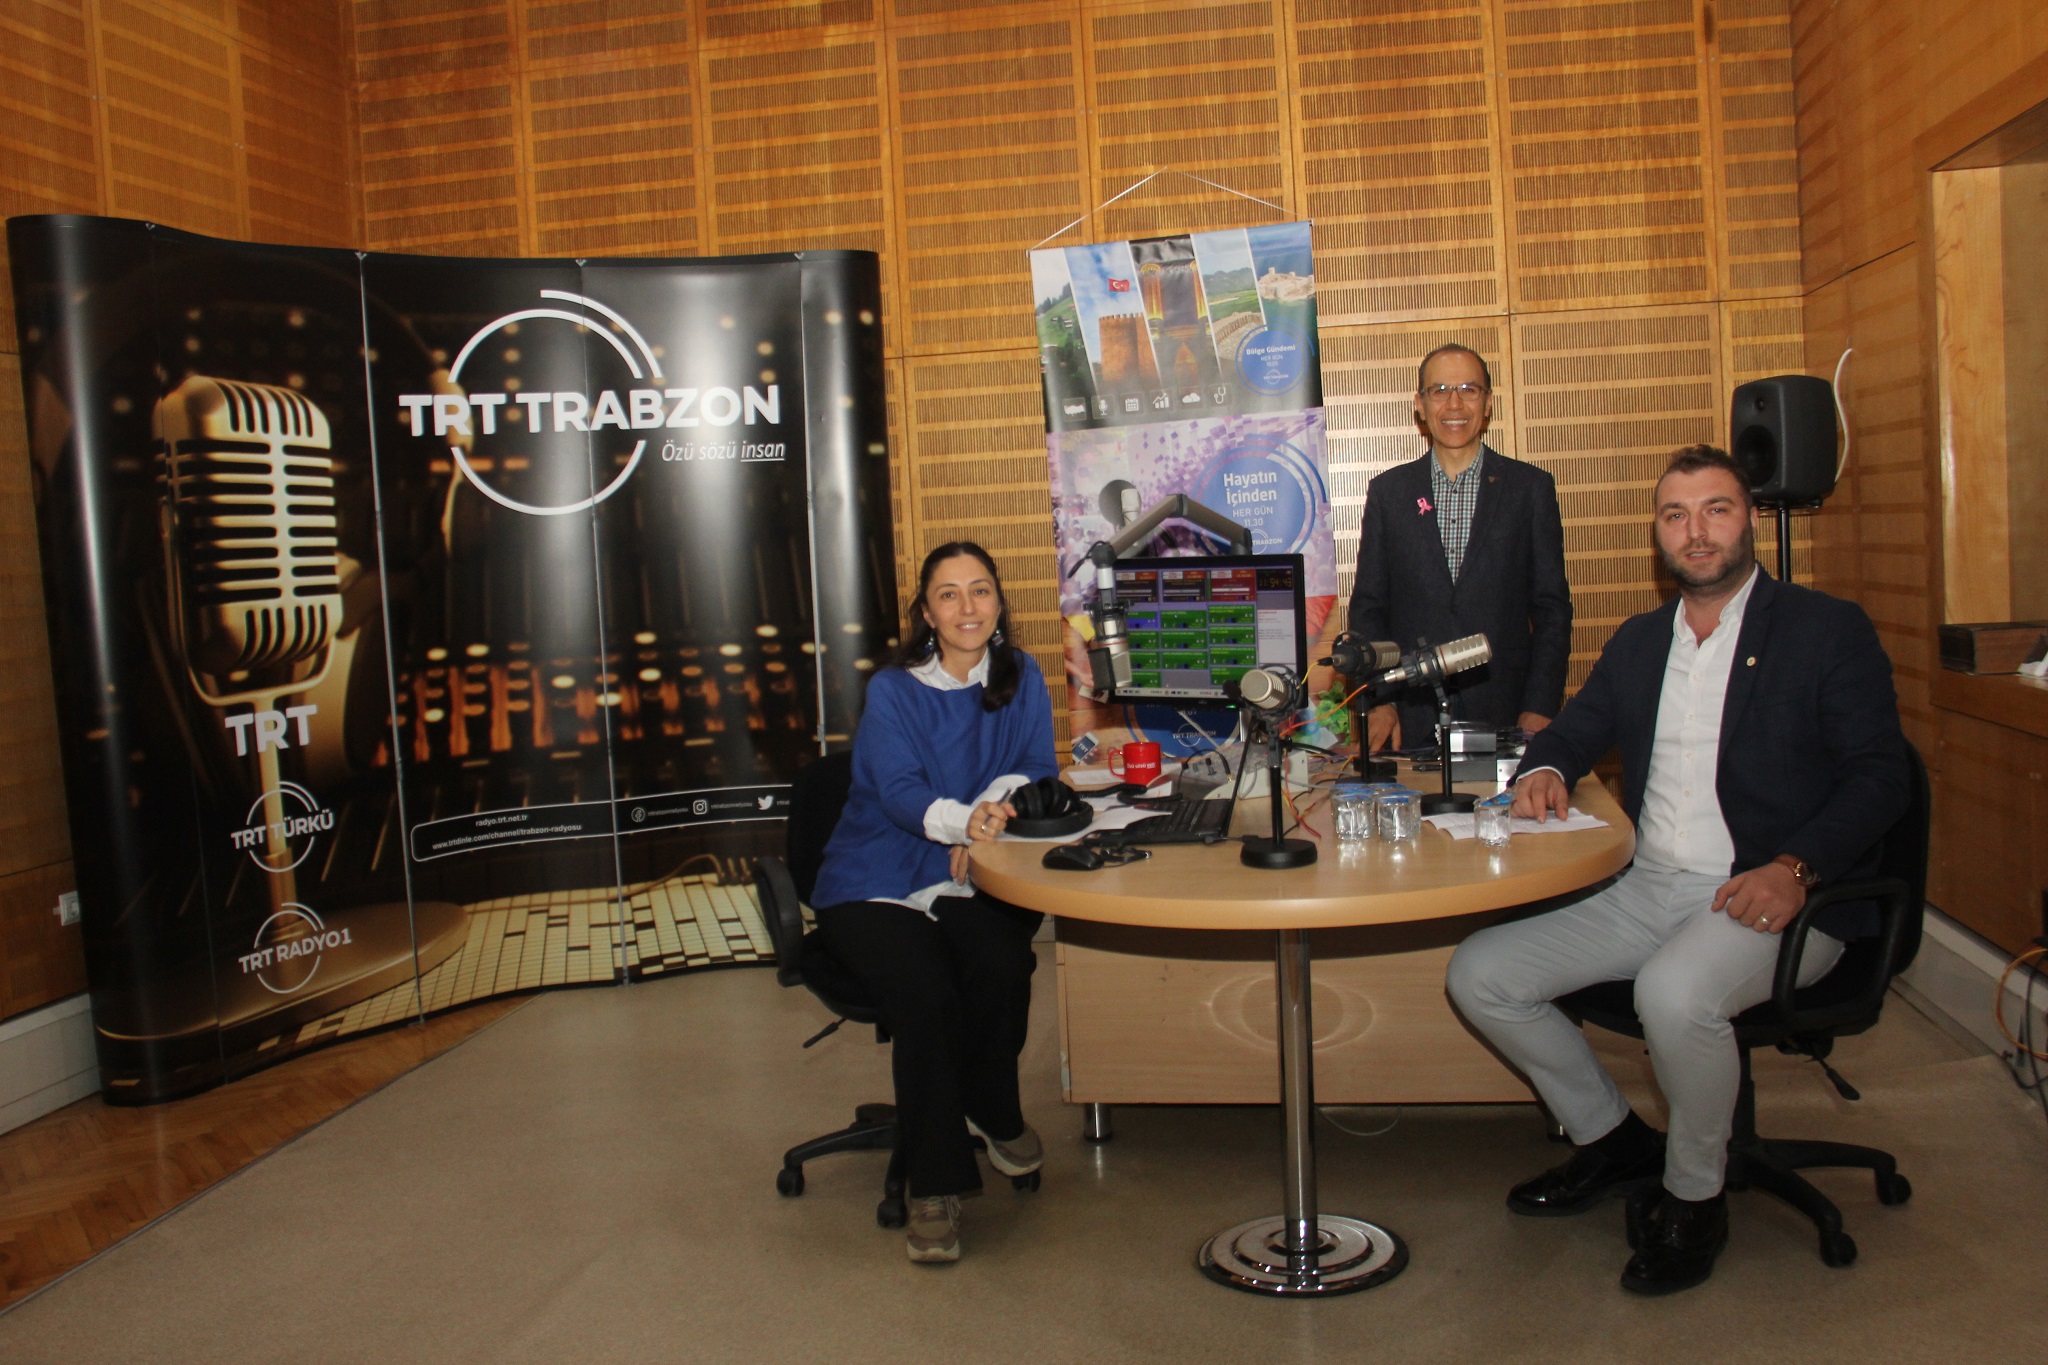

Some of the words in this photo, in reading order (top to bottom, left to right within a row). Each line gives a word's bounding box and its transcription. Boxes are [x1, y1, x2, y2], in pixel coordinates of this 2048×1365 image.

[399, 393, 507, 438] TRT
[515, 384, 781, 434] TRABZON
[661, 440, 694, 462] Özü
[698, 441, 736, 460] sözü
[741, 440, 785, 460] insan
[1223, 471, 1278, 488] Hayatın
[1226, 488, 1278, 507] İçinden
[1232, 508, 1252, 518] HER
[1254, 505, 1274, 516] GÜN
[1244, 518, 1264, 527] 11.30
[1252, 537, 1283, 546] TRABZON
[225, 704, 318, 757] TRT
[231, 826, 267, 850] TRT
[269, 808, 335, 840] TÜRKÜ
[475, 814, 529, 828] radyo.trt.net.tr
[238, 949, 273, 974] TRT
[276, 928, 353, 963] RADYO1
